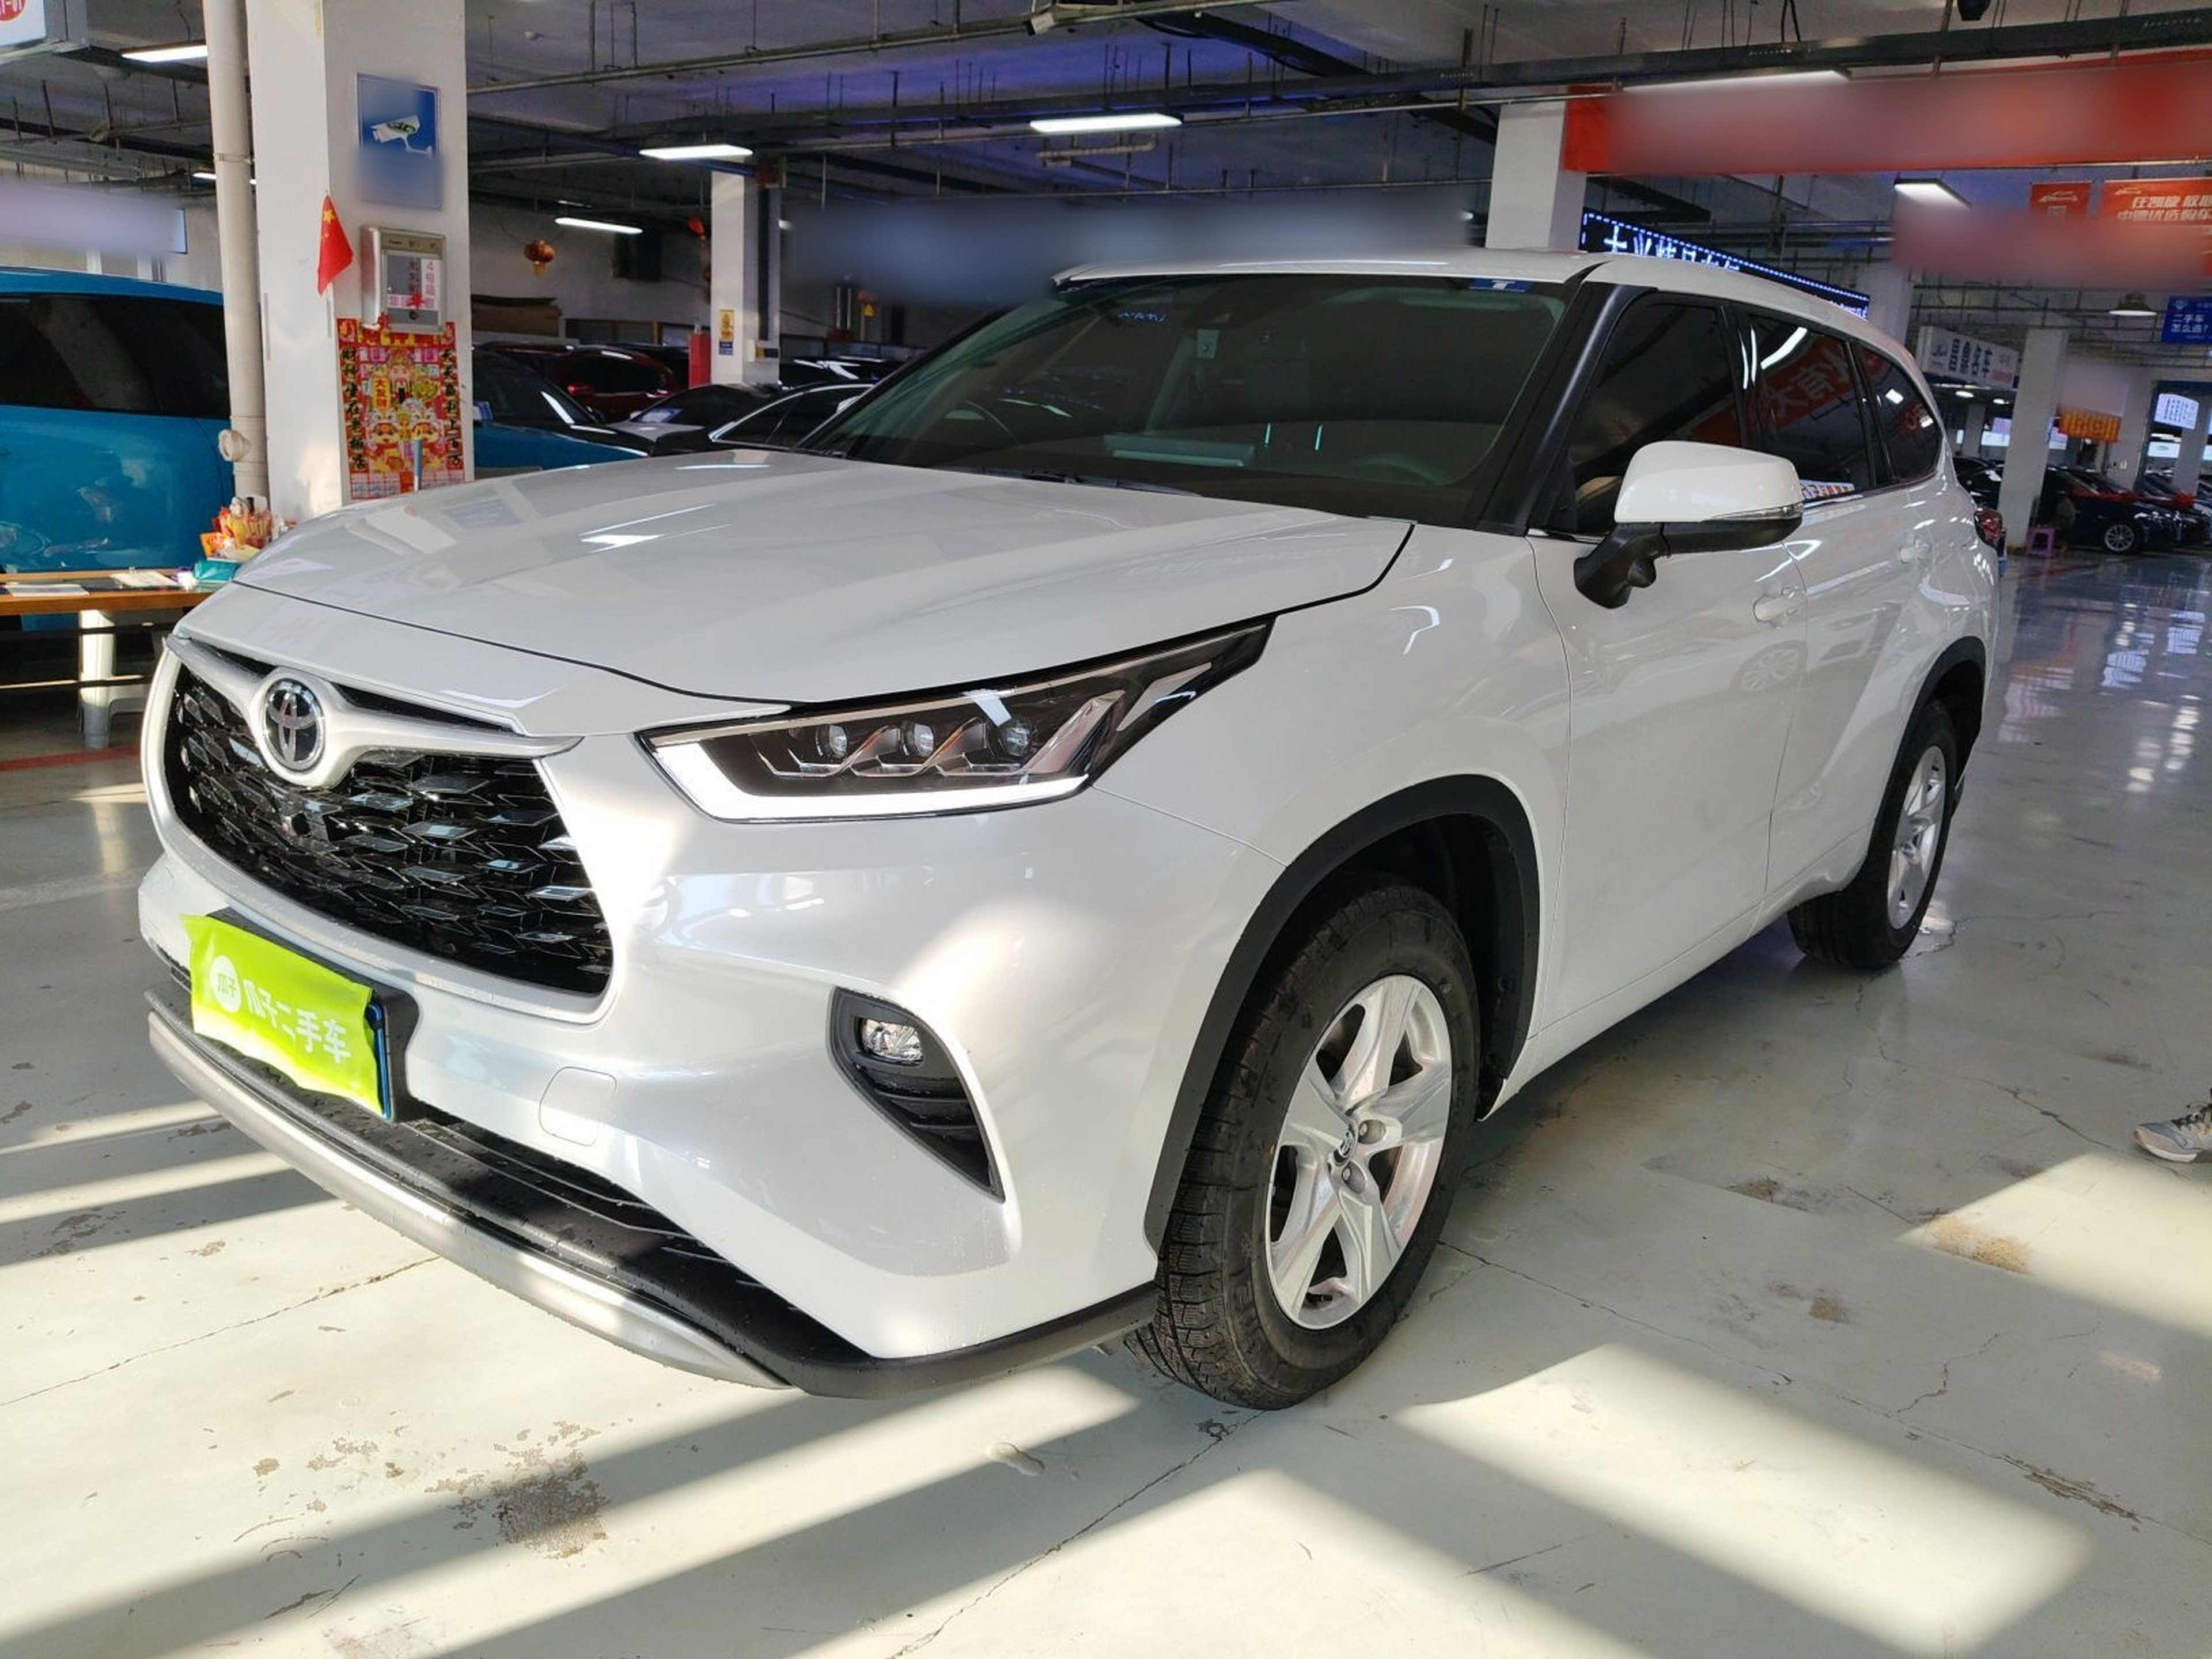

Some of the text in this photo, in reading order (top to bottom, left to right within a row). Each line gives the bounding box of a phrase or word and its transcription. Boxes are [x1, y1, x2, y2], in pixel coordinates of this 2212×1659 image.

[243, 979, 351, 1063] 瓜子二手车
